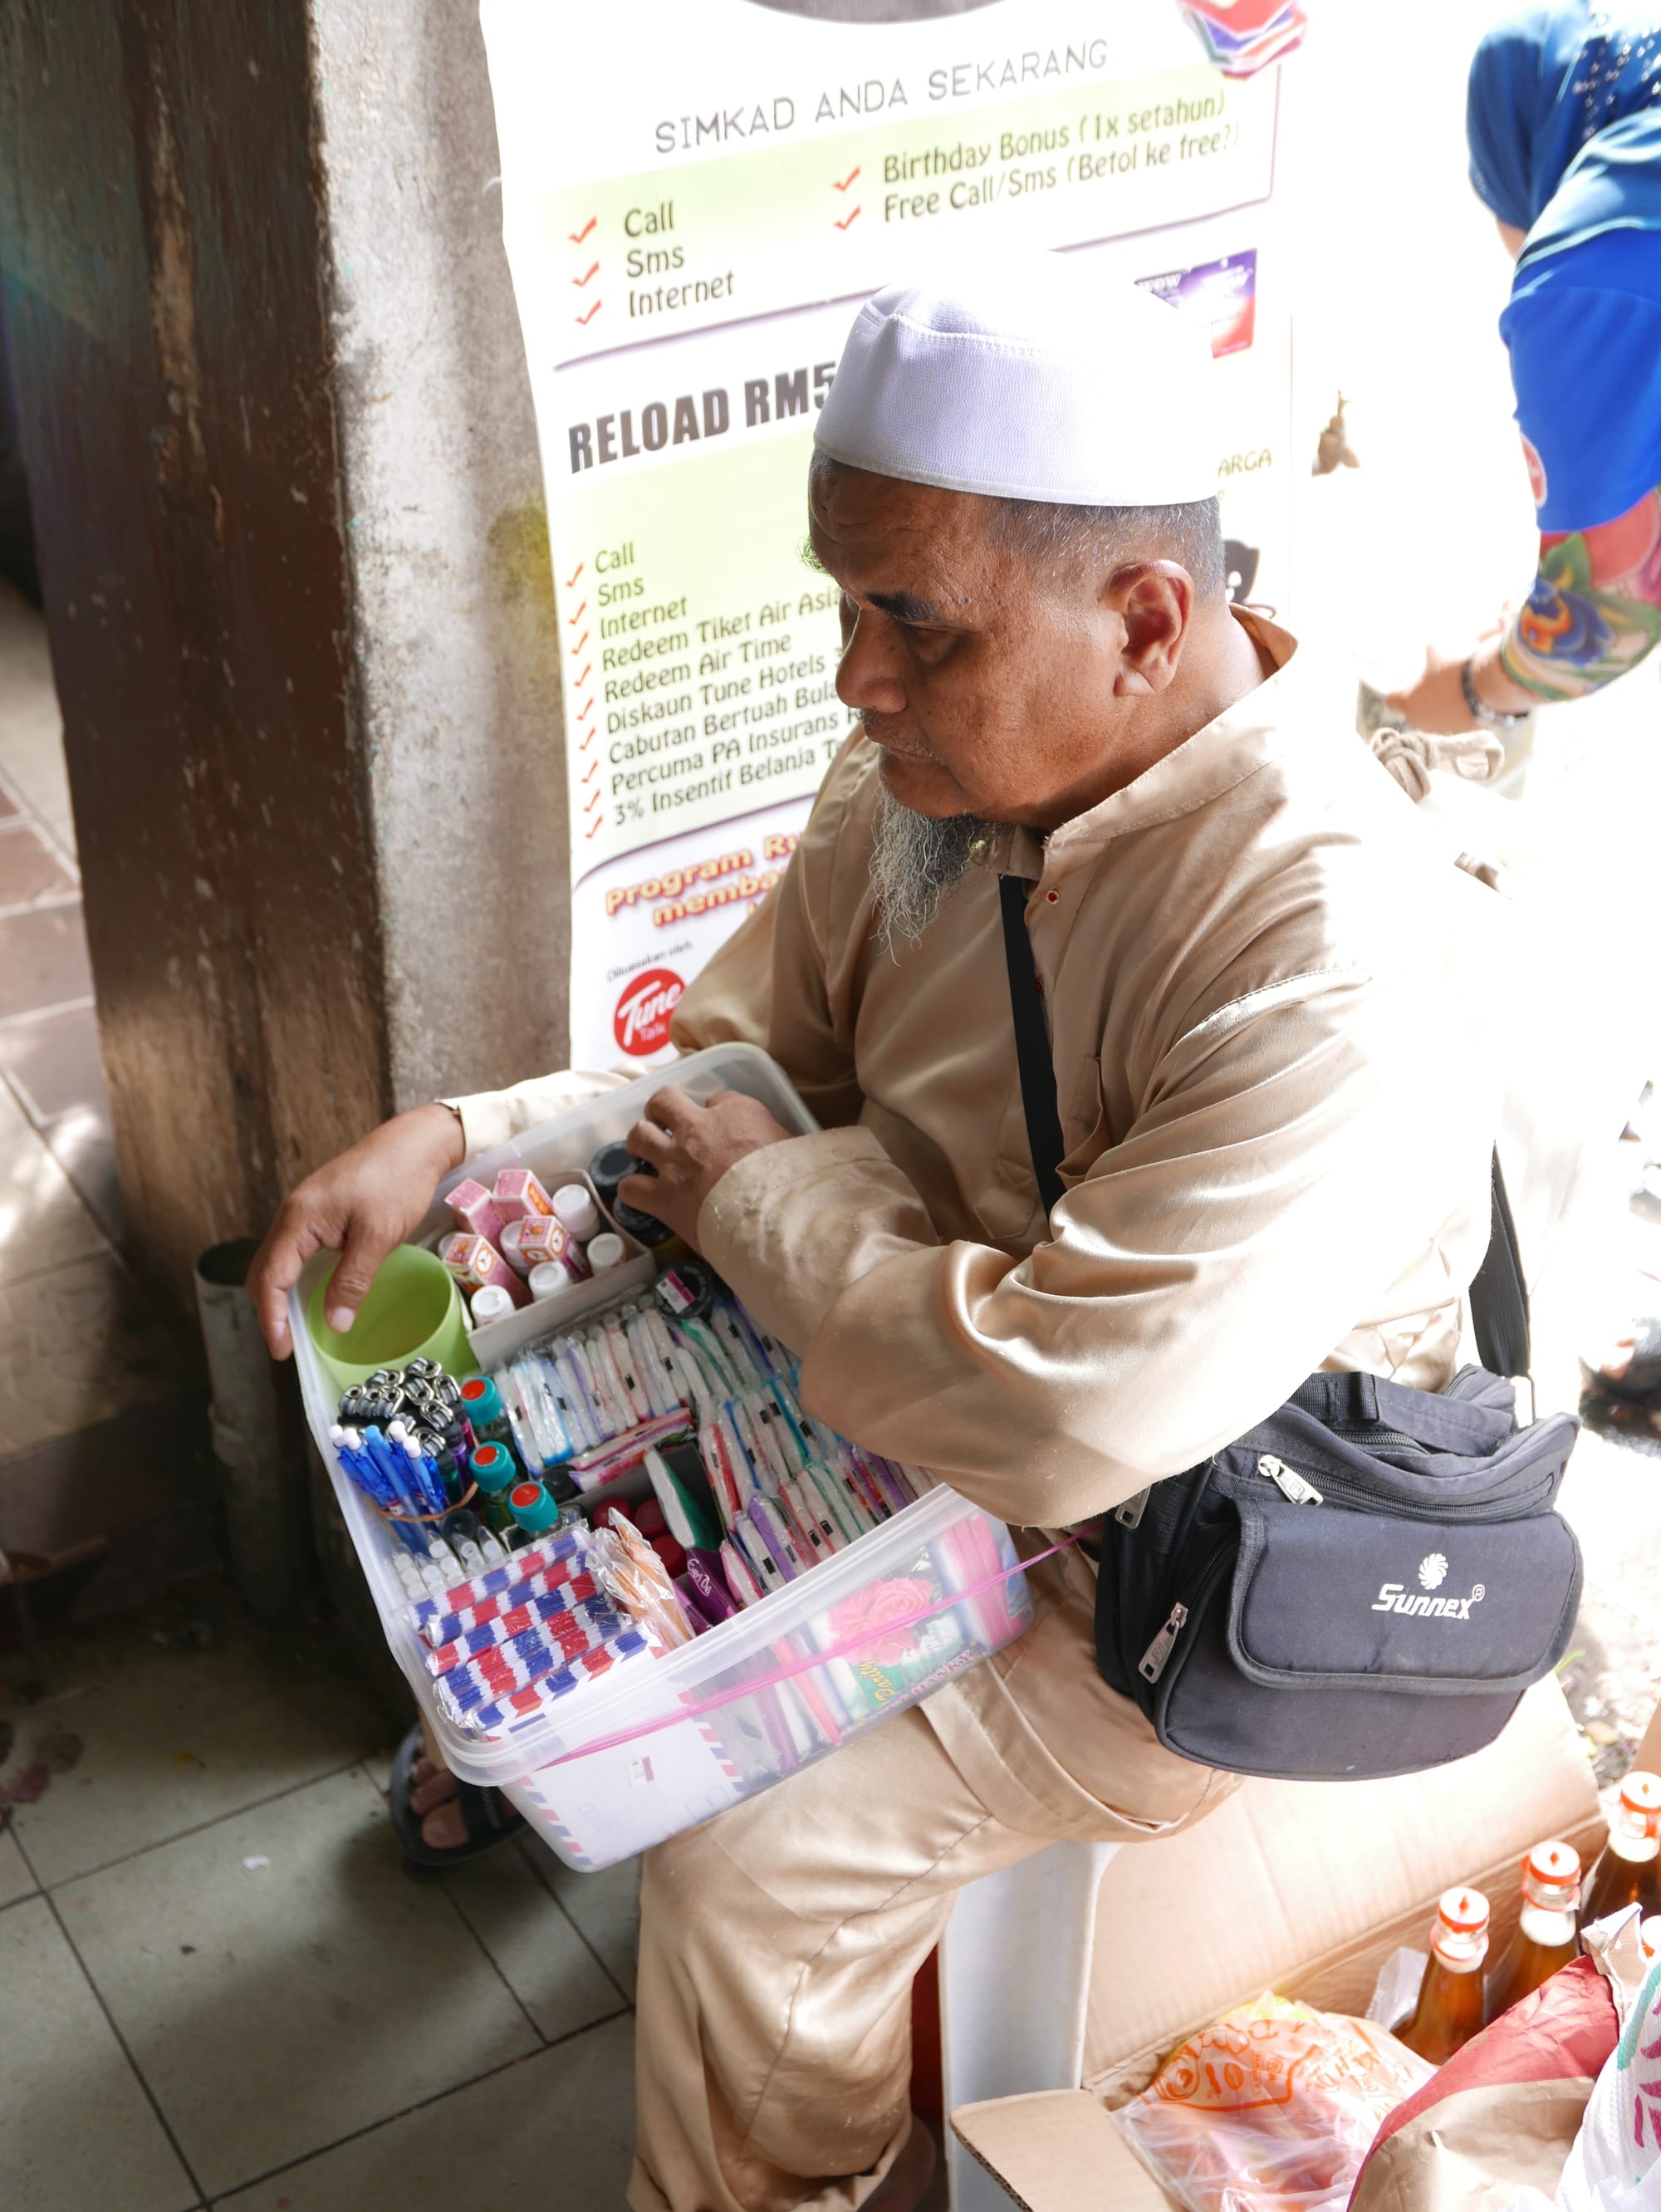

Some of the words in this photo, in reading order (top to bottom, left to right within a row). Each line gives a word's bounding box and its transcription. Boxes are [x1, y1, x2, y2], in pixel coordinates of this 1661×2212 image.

[655, 96, 795, 153] SIMKAD
[815, 79, 908, 123] ANDA
[928, 39, 1108, 101] SEKARANG
[884, 142, 991, 184] Birthday
[1000, 123, 1069, 160] Bonus
[1128, 90, 1225, 131] setahun)
[884, 189, 939, 223] Free
[1067, 145, 1138, 183] (Betol
[1145, 136, 1171, 164] ke
[625, 201, 674, 237] Call
[626, 246, 684, 278] Sms
[629, 272, 734, 317] Internet
[568, 388, 729, 473] RELOAD
[595, 542, 635, 573] Call
[598, 578, 644, 606] Sms
[600, 597, 688, 639] Internet
[602, 631, 688, 671] Redeem
[696, 613, 751, 642] Tiket
[759, 601, 791, 627] Air
[605, 663, 691, 704] Redeem
[699, 650, 732, 675] Air
[739, 634, 791, 663] Time
[607, 693, 692, 734] Diskaun
[699, 676, 752, 704] Tune
[760, 653, 826, 689] Hotels
[609, 723, 695, 764] Cabutan
[704, 695, 786, 736] Bertuah
[611, 753, 703, 795] Percuma
[713, 738, 742, 763] PA
[749, 710, 838, 752] Insurans
[615, 799, 644, 826] 3%
[652, 770, 733, 812] Insentif
[740, 747, 816, 787] Belanja
[605, 848, 752, 915] Program
[617, 980, 681, 1047] Tune
[639, 1022, 666, 1042] Talk
[1371, 1583, 1473, 1619] Sunnex
[912, 1649, 971, 1695] HANKY
